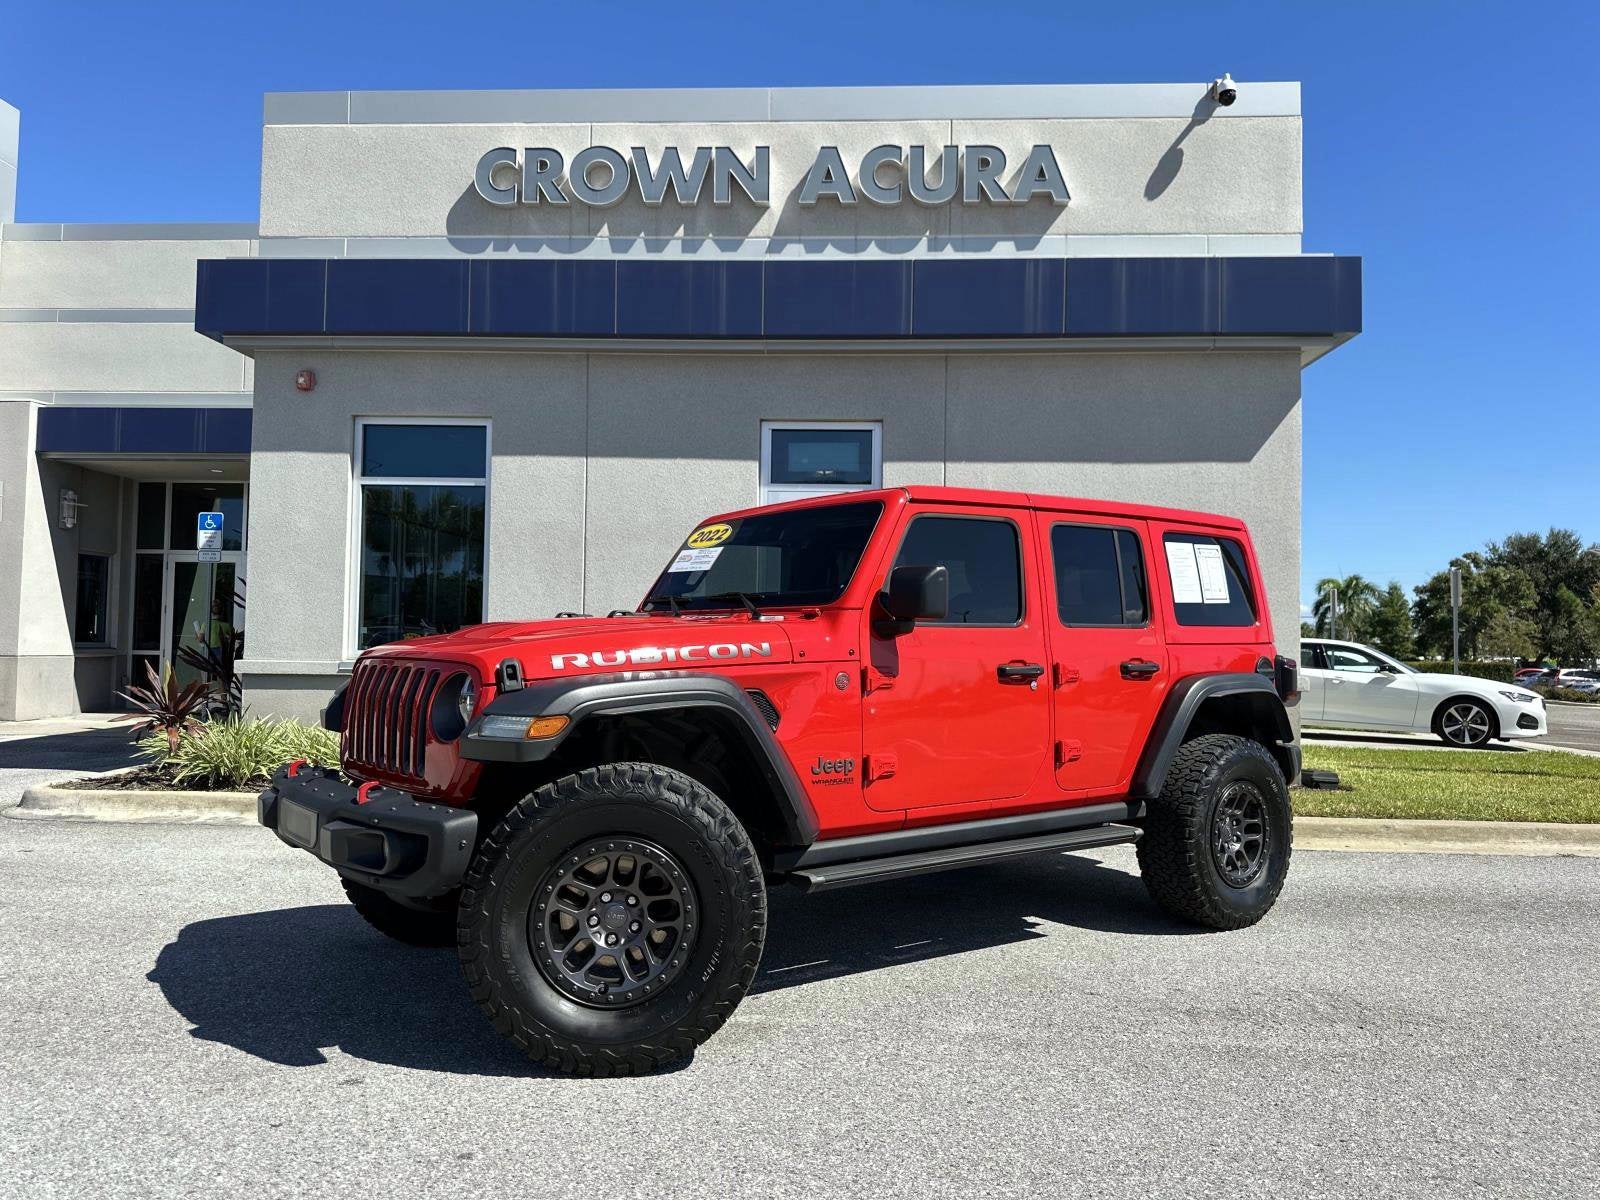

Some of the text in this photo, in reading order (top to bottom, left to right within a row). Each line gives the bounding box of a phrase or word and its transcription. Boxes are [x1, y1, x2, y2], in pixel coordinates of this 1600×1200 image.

[474, 144, 1071, 205] CROWN ACURA
[690, 528, 730, 543] 2022
[551, 642, 771, 670] RUBICON
[811, 756, 855, 776] Jeep
